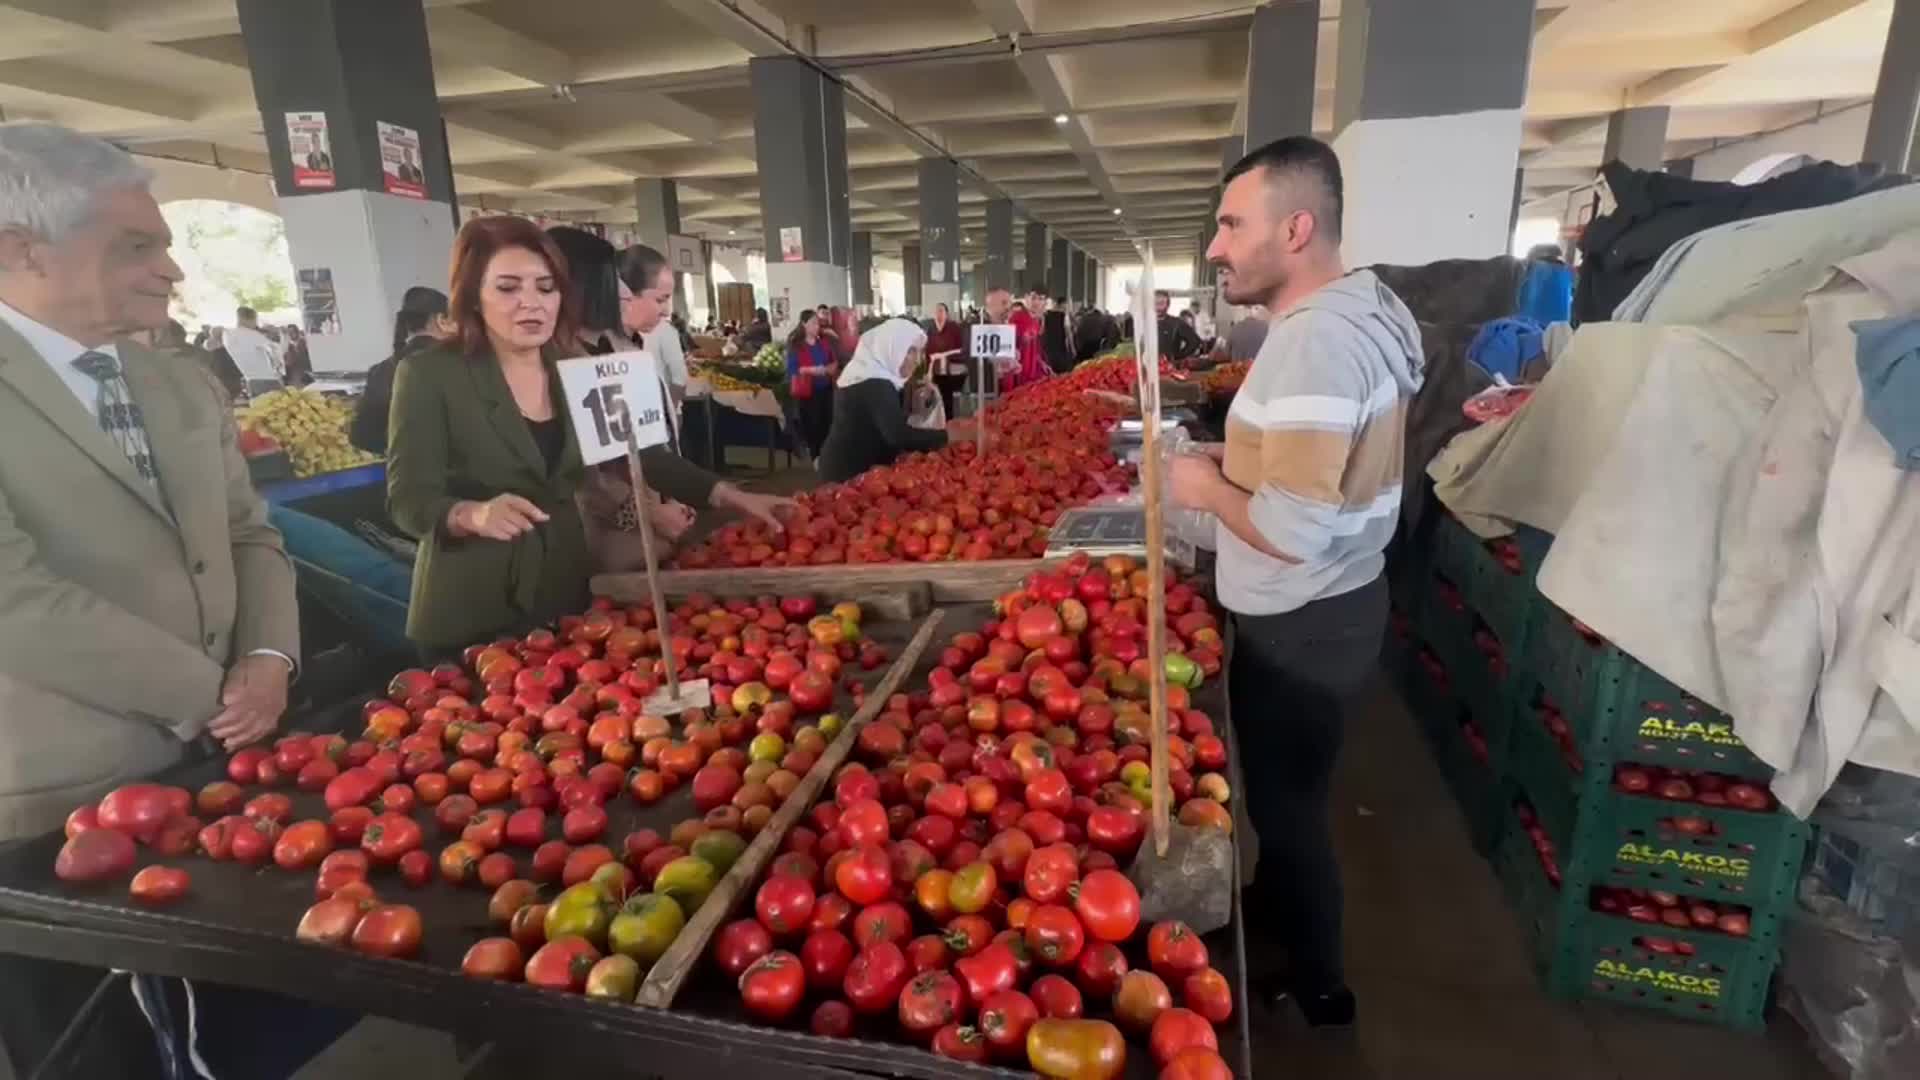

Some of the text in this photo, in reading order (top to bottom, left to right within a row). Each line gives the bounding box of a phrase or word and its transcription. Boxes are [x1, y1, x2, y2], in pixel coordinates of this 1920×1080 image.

[977, 333, 1000, 354] 30
[595, 361, 629, 379] KILO
[582, 384, 632, 447] 15
[1641, 717, 1730, 737] ALAK
